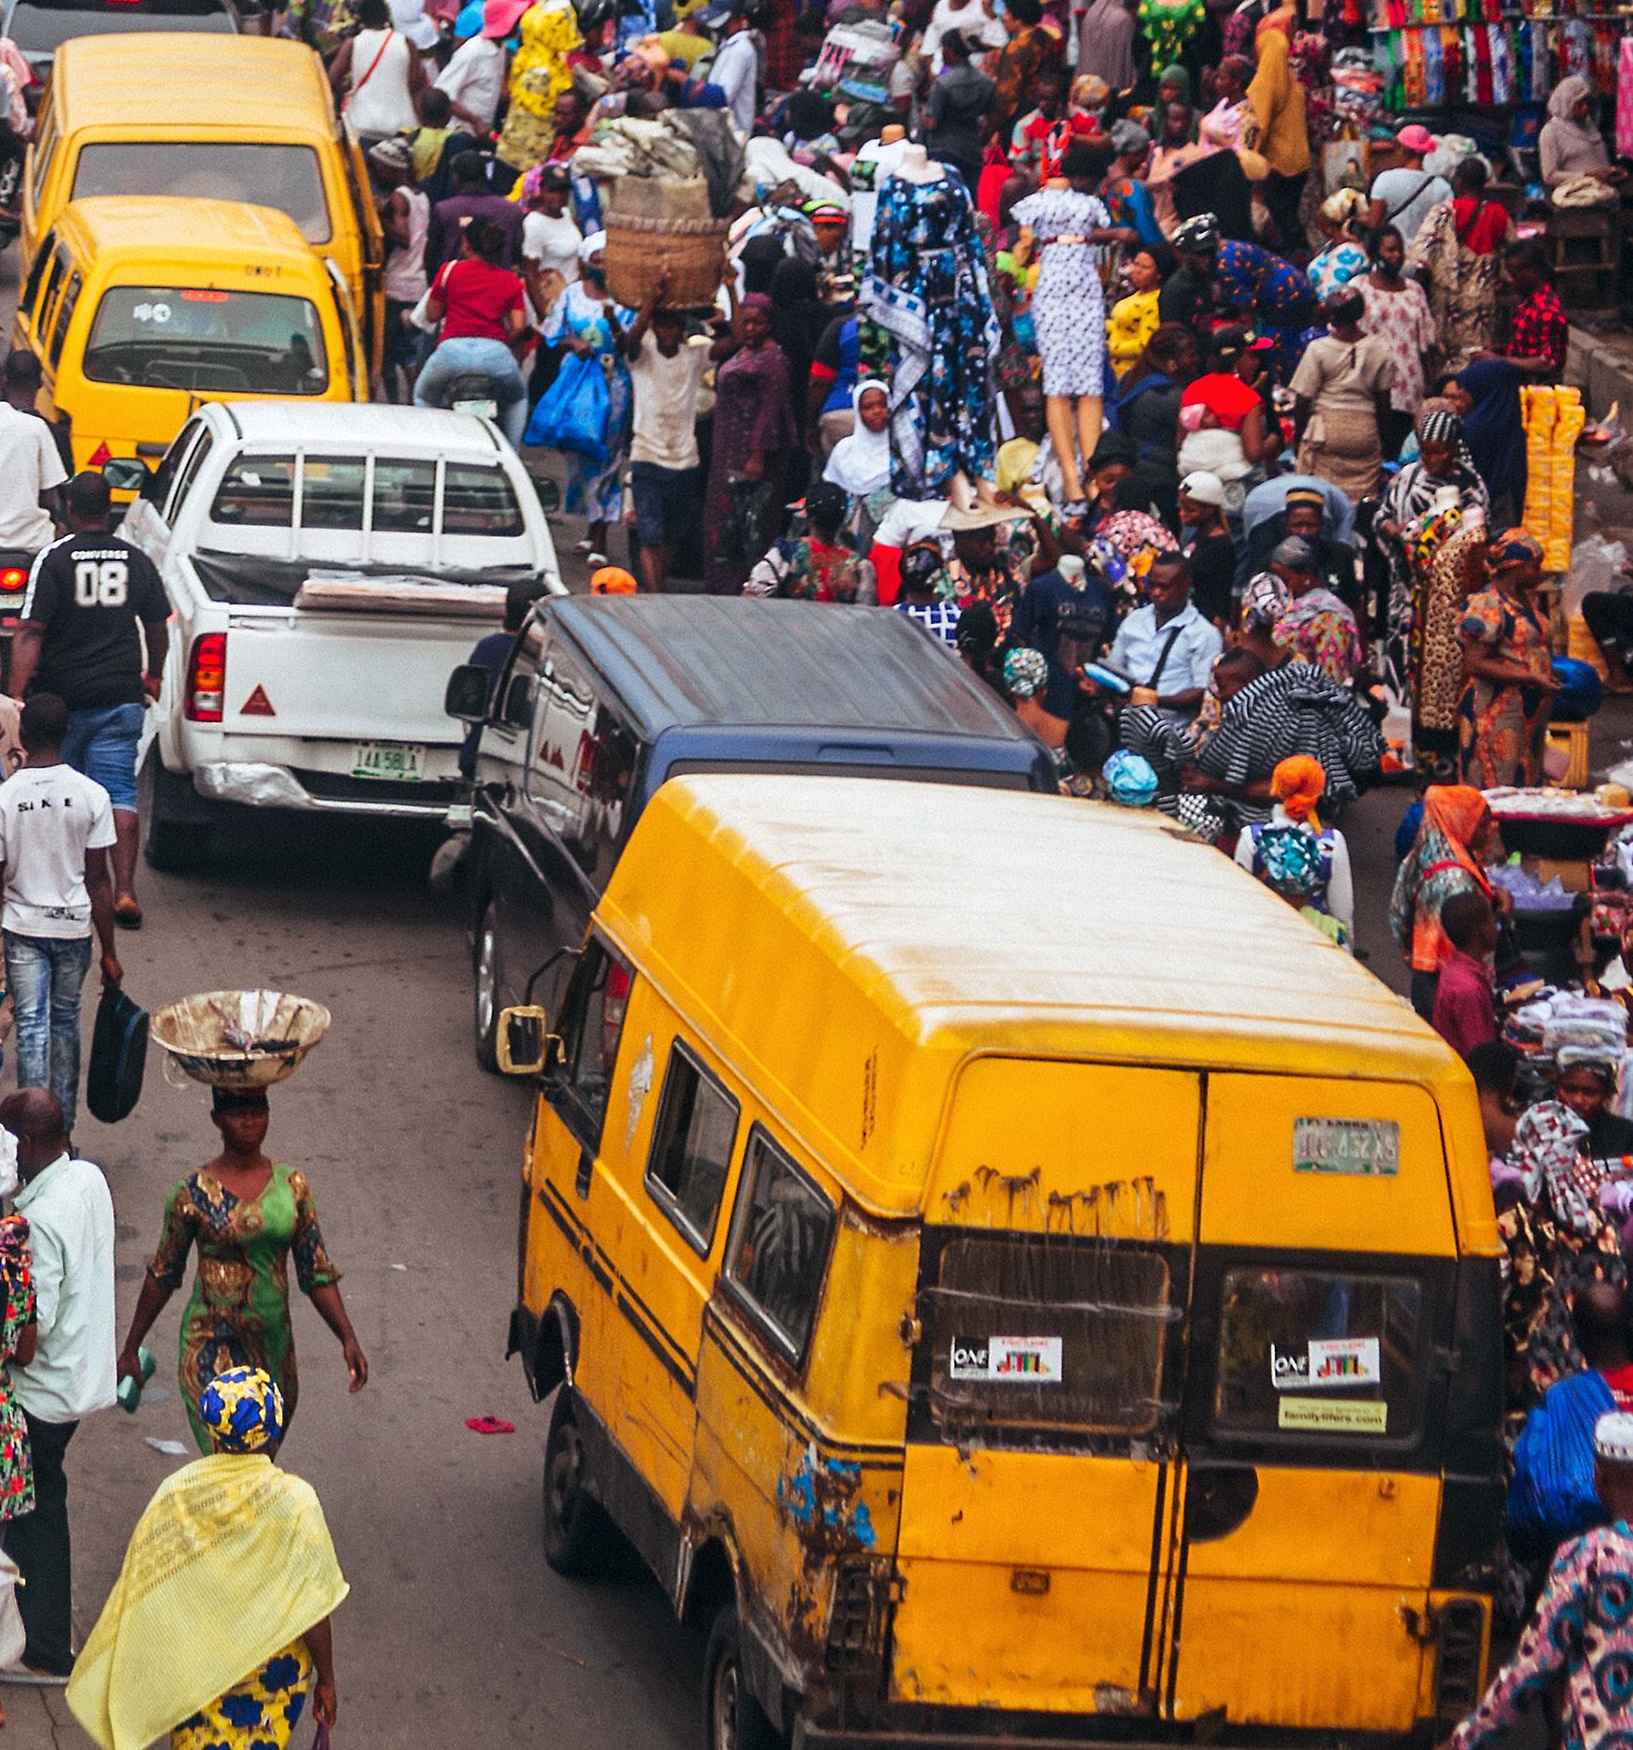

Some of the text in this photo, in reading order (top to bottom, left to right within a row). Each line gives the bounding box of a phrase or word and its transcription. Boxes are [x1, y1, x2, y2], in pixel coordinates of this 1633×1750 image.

[74, 560, 130, 607] 08
[954, 1347, 988, 1366] ONE
[1275, 1354, 1309, 1376] ONE
